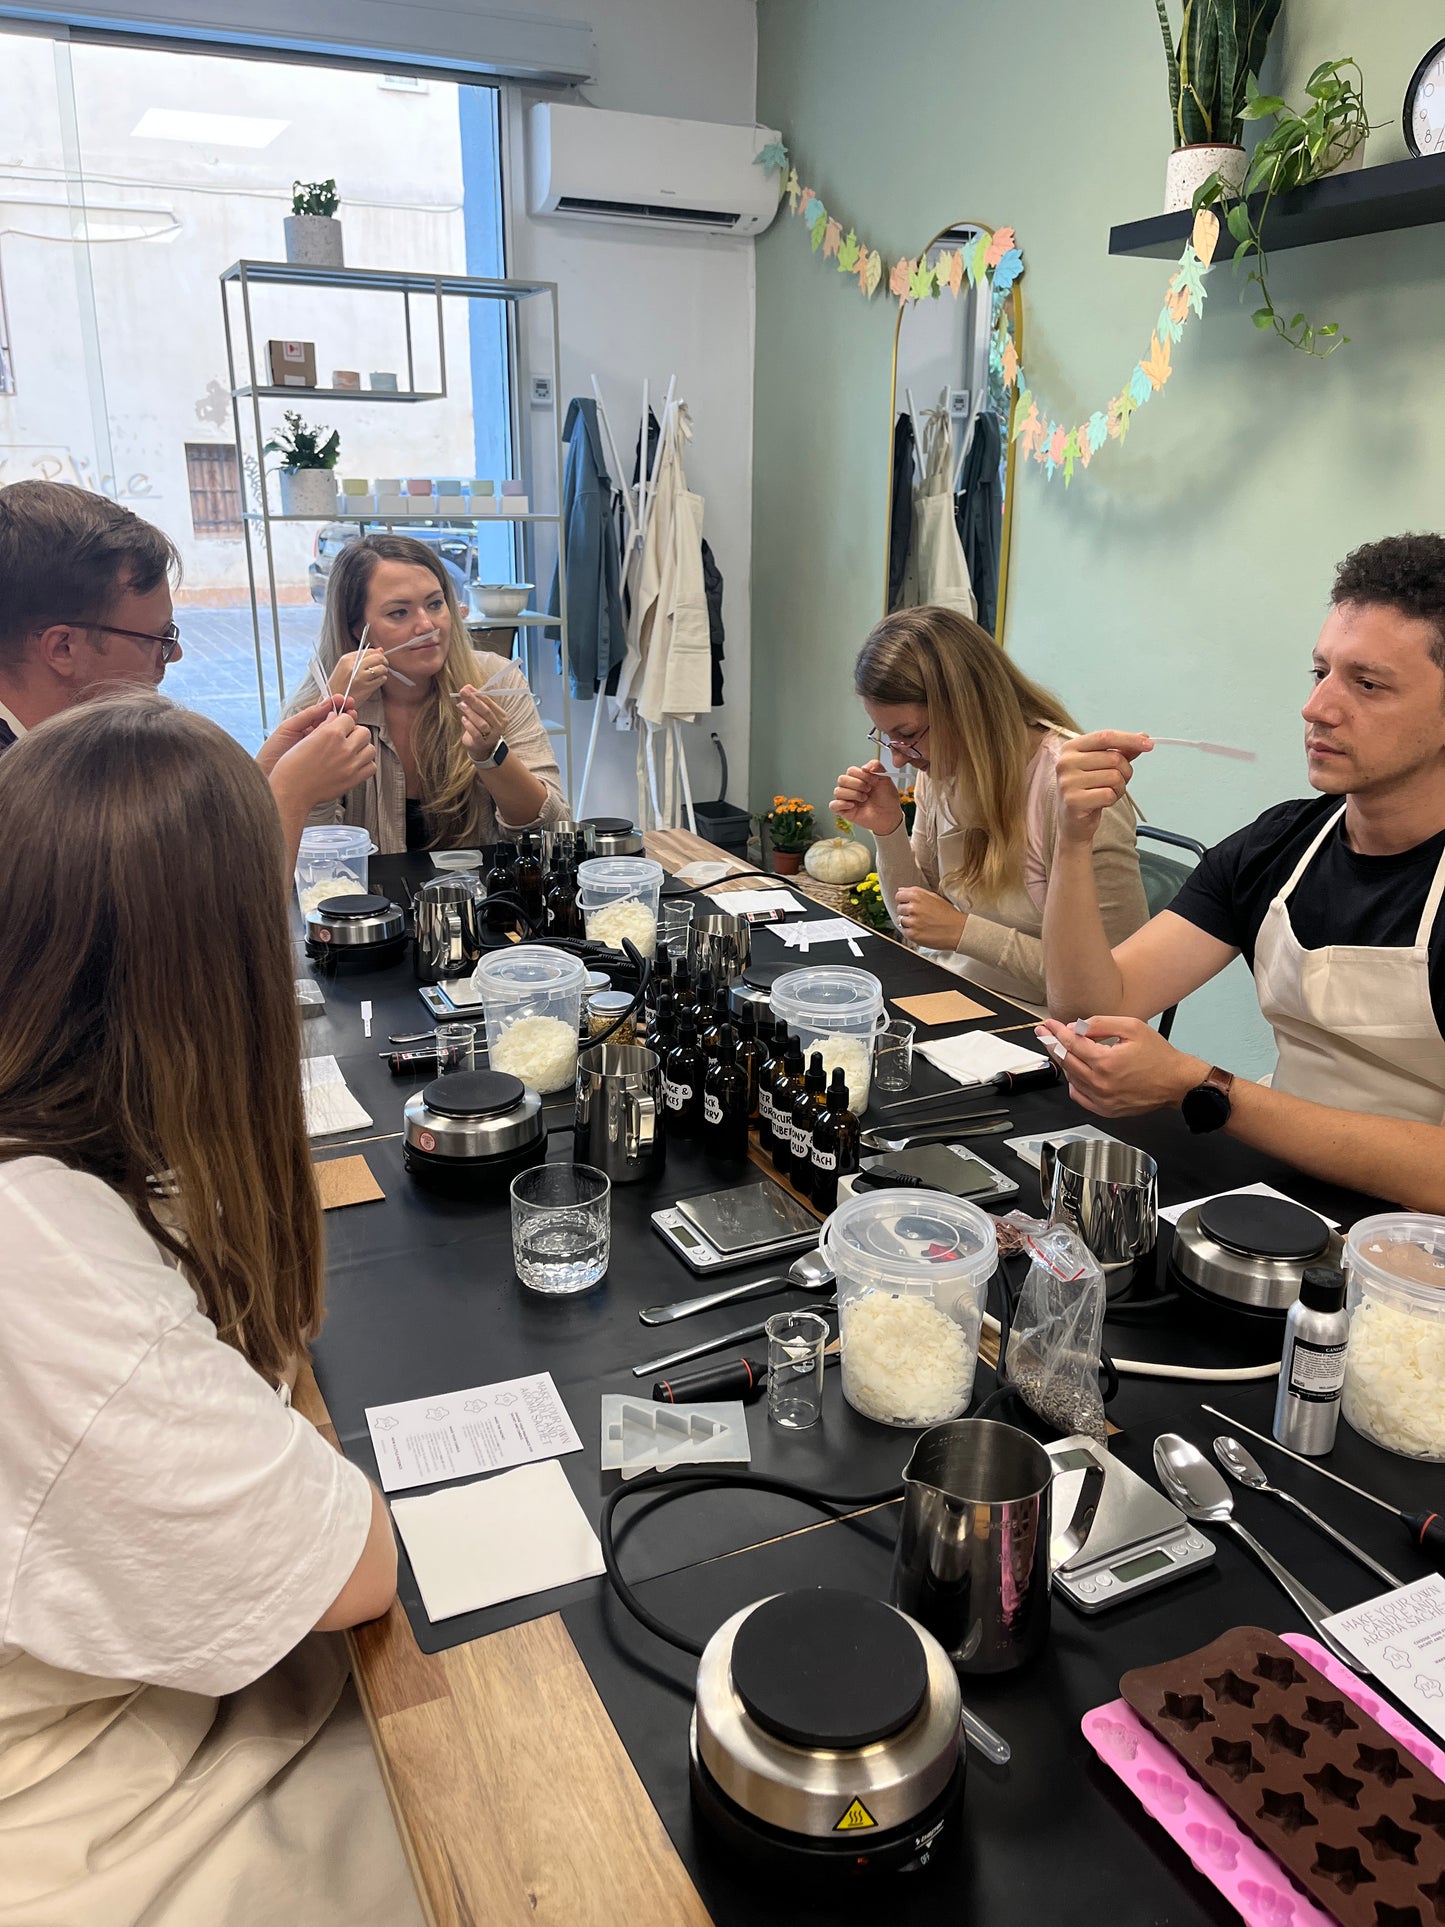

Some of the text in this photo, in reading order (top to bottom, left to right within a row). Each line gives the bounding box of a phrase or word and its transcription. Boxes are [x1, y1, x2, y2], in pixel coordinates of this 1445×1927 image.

[1420, 109, 1427, 121] 9
[1424, 129, 1432, 143] 8
[32, 455, 153, 497] Plice
[1341, 1585, 1441, 1632] MAKE YOUR OWN
[1362, 1598, 1437, 1636] CANDLE AND
[1363, 1622, 1408, 1648] AROMA
